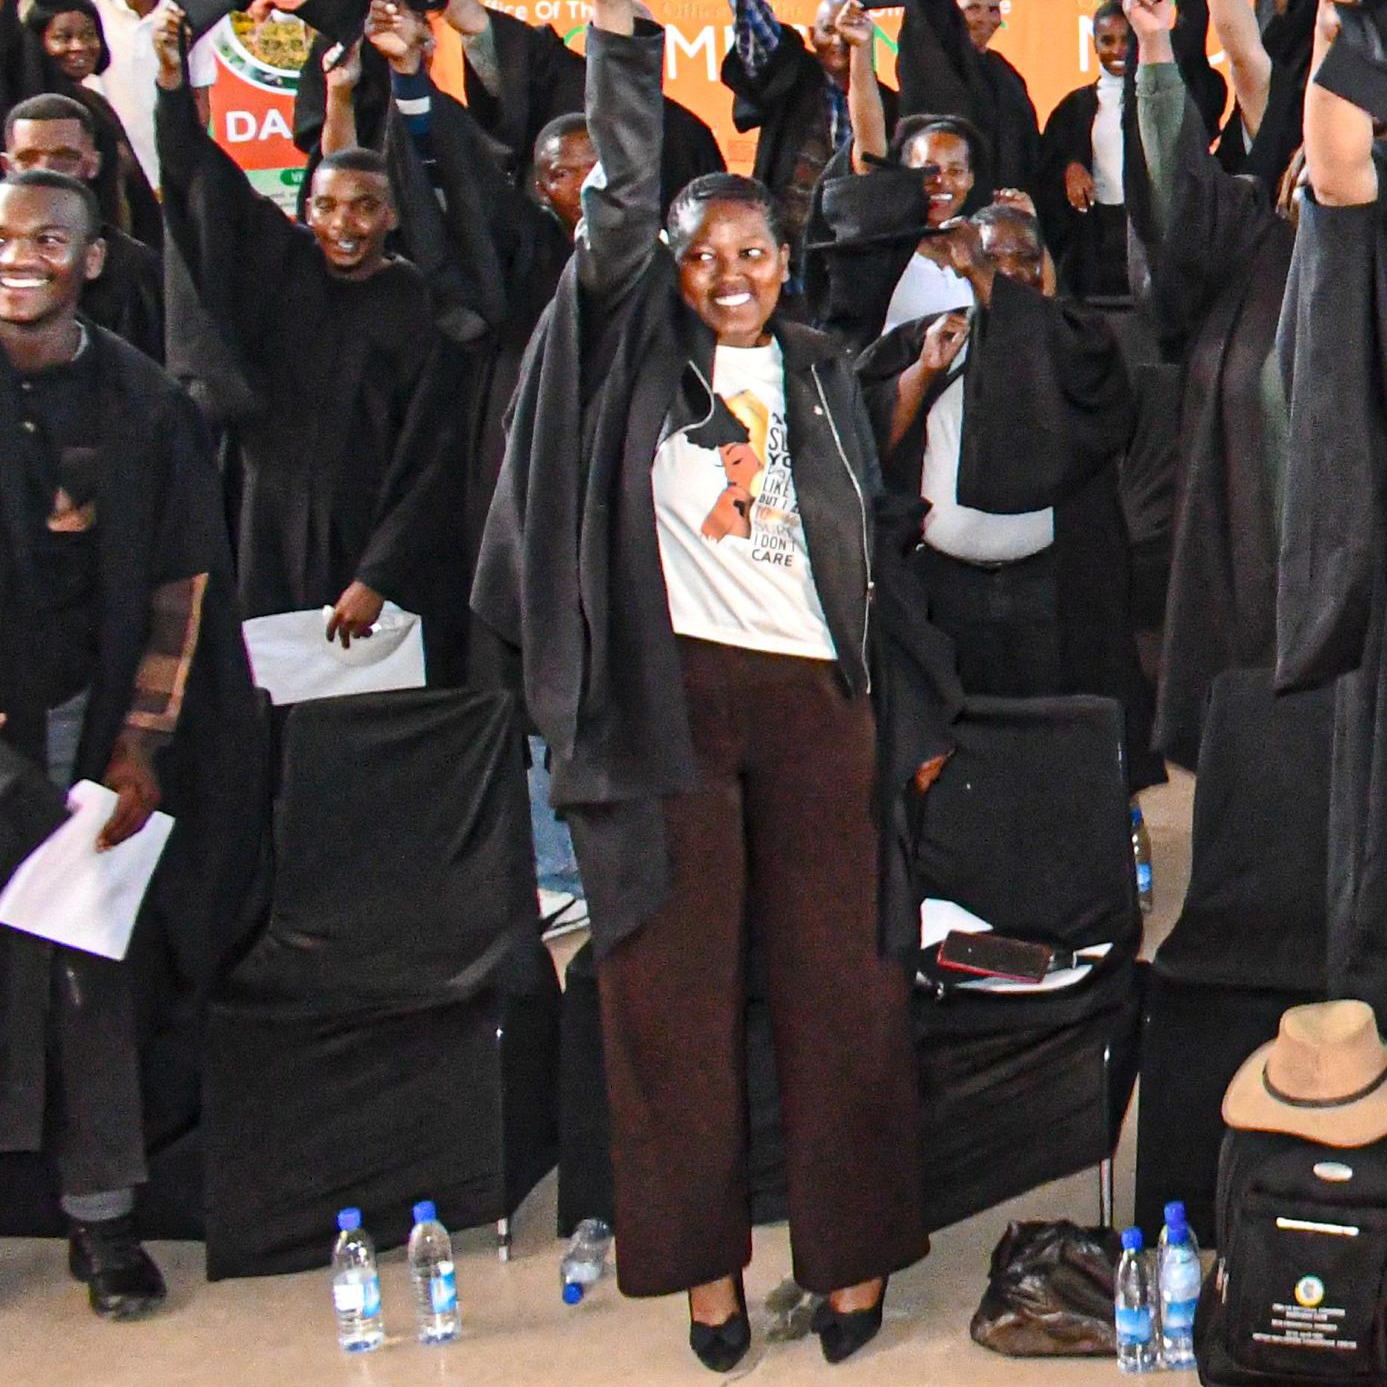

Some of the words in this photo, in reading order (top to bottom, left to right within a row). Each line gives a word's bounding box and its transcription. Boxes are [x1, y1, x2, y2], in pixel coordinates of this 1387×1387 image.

[535, 0, 561, 20] Of
[566, 0, 594, 19] Th
[751, 548, 793, 567] CARE
